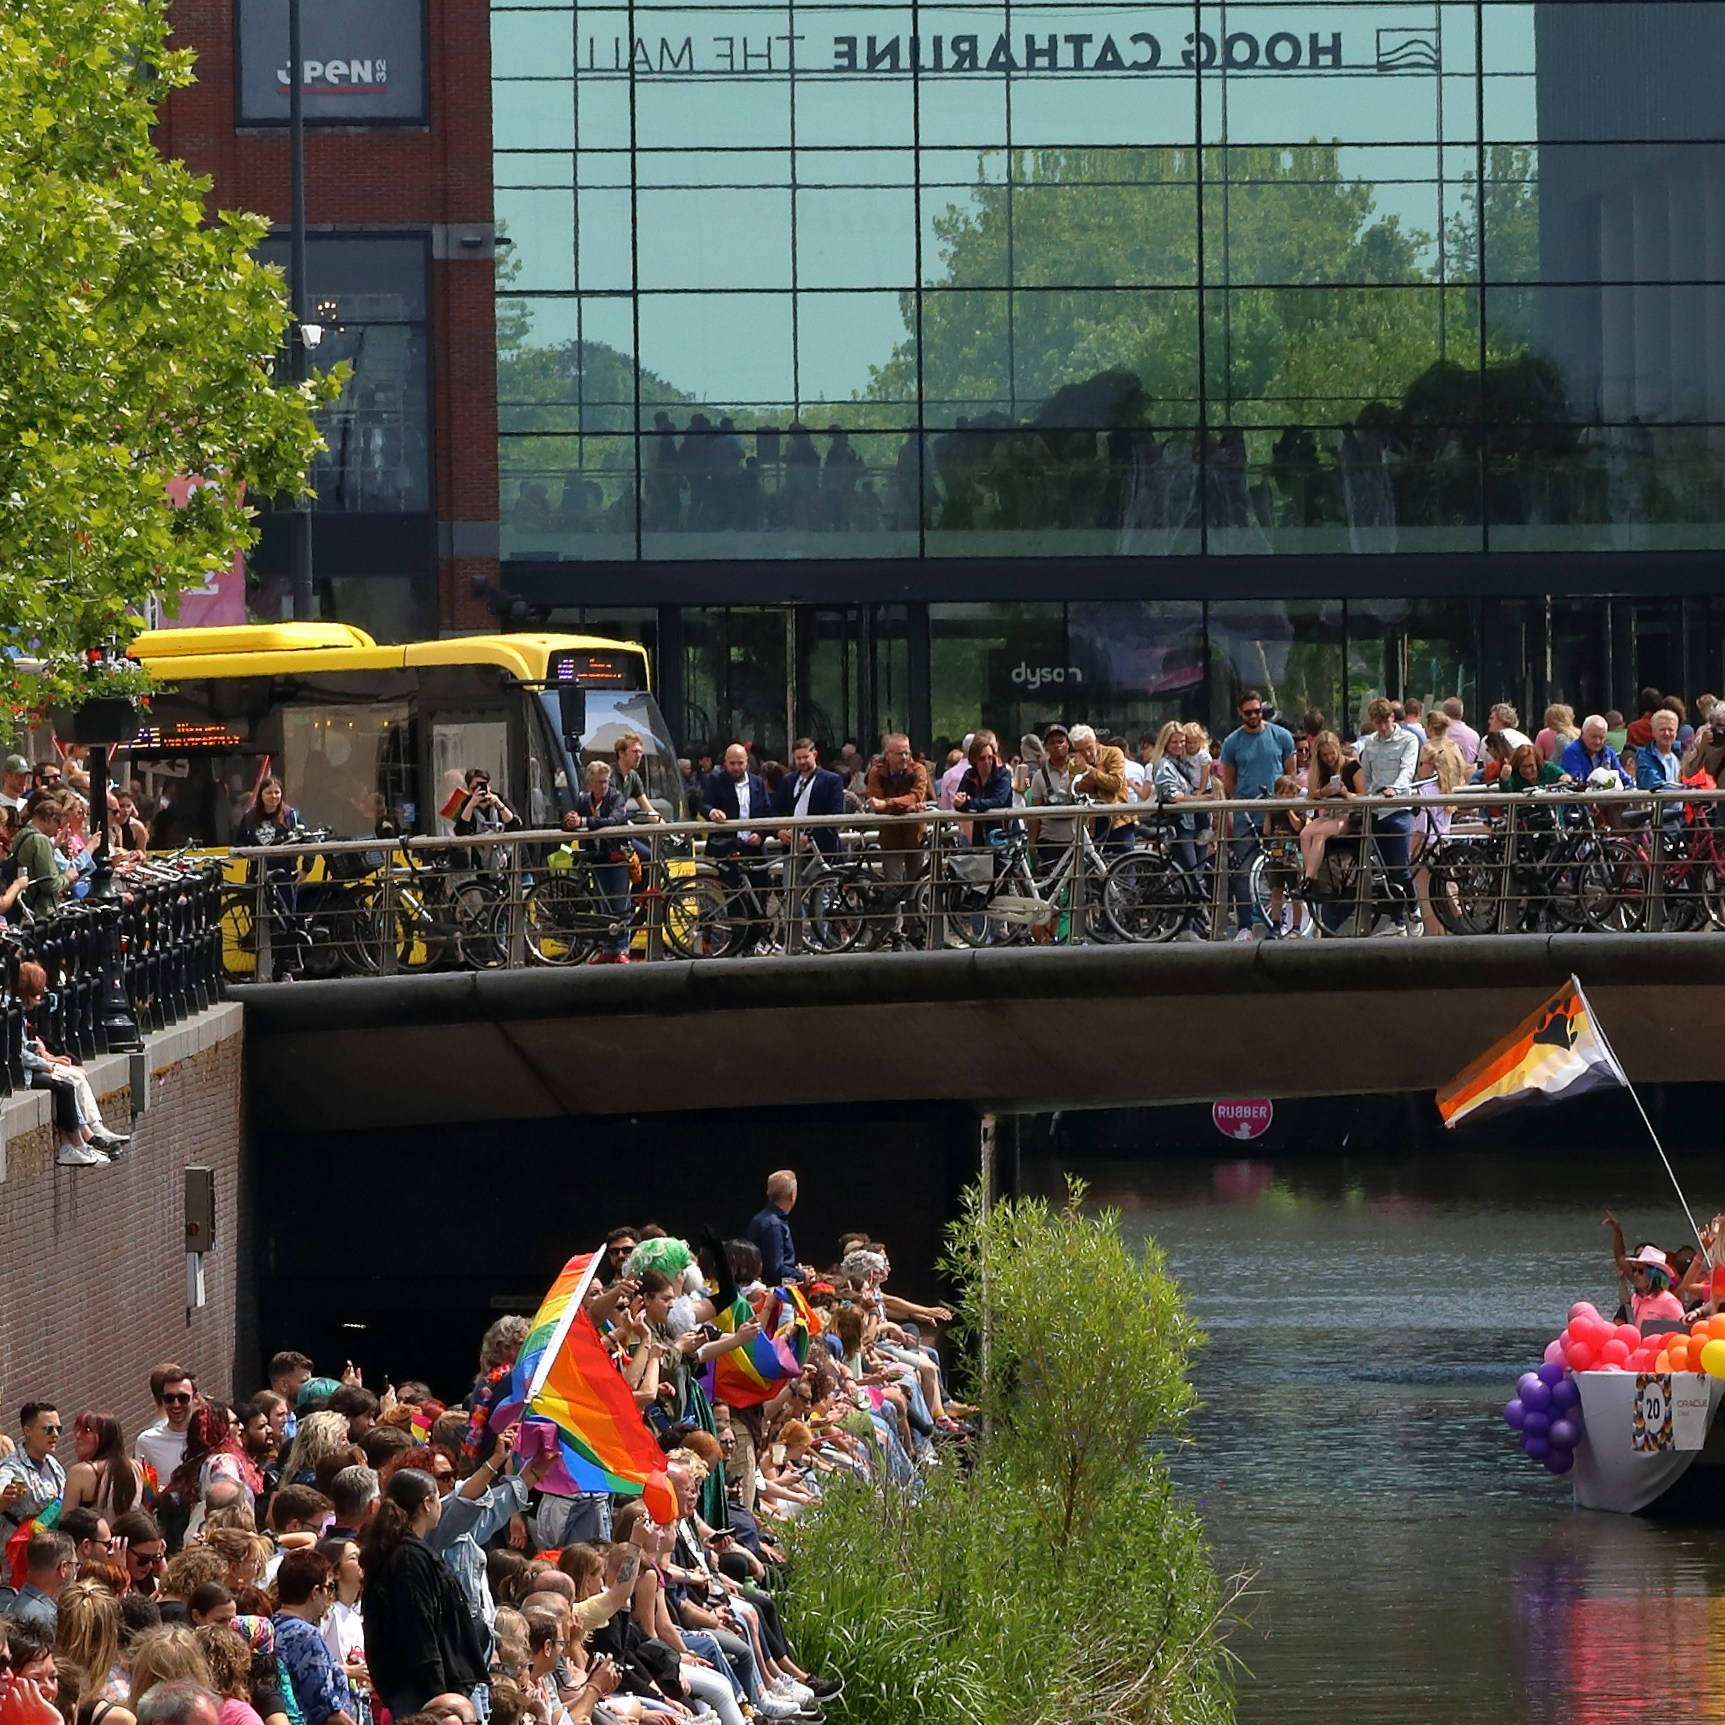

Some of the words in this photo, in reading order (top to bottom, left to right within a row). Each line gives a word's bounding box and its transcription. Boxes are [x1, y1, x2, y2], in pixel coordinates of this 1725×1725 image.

[1011, 661, 1083, 690] dyson
[1218, 1105, 1268, 1119] RUBBER
[1646, 1398, 1660, 1420] 20
[1676, 1399, 1708, 1408] ORACLE
